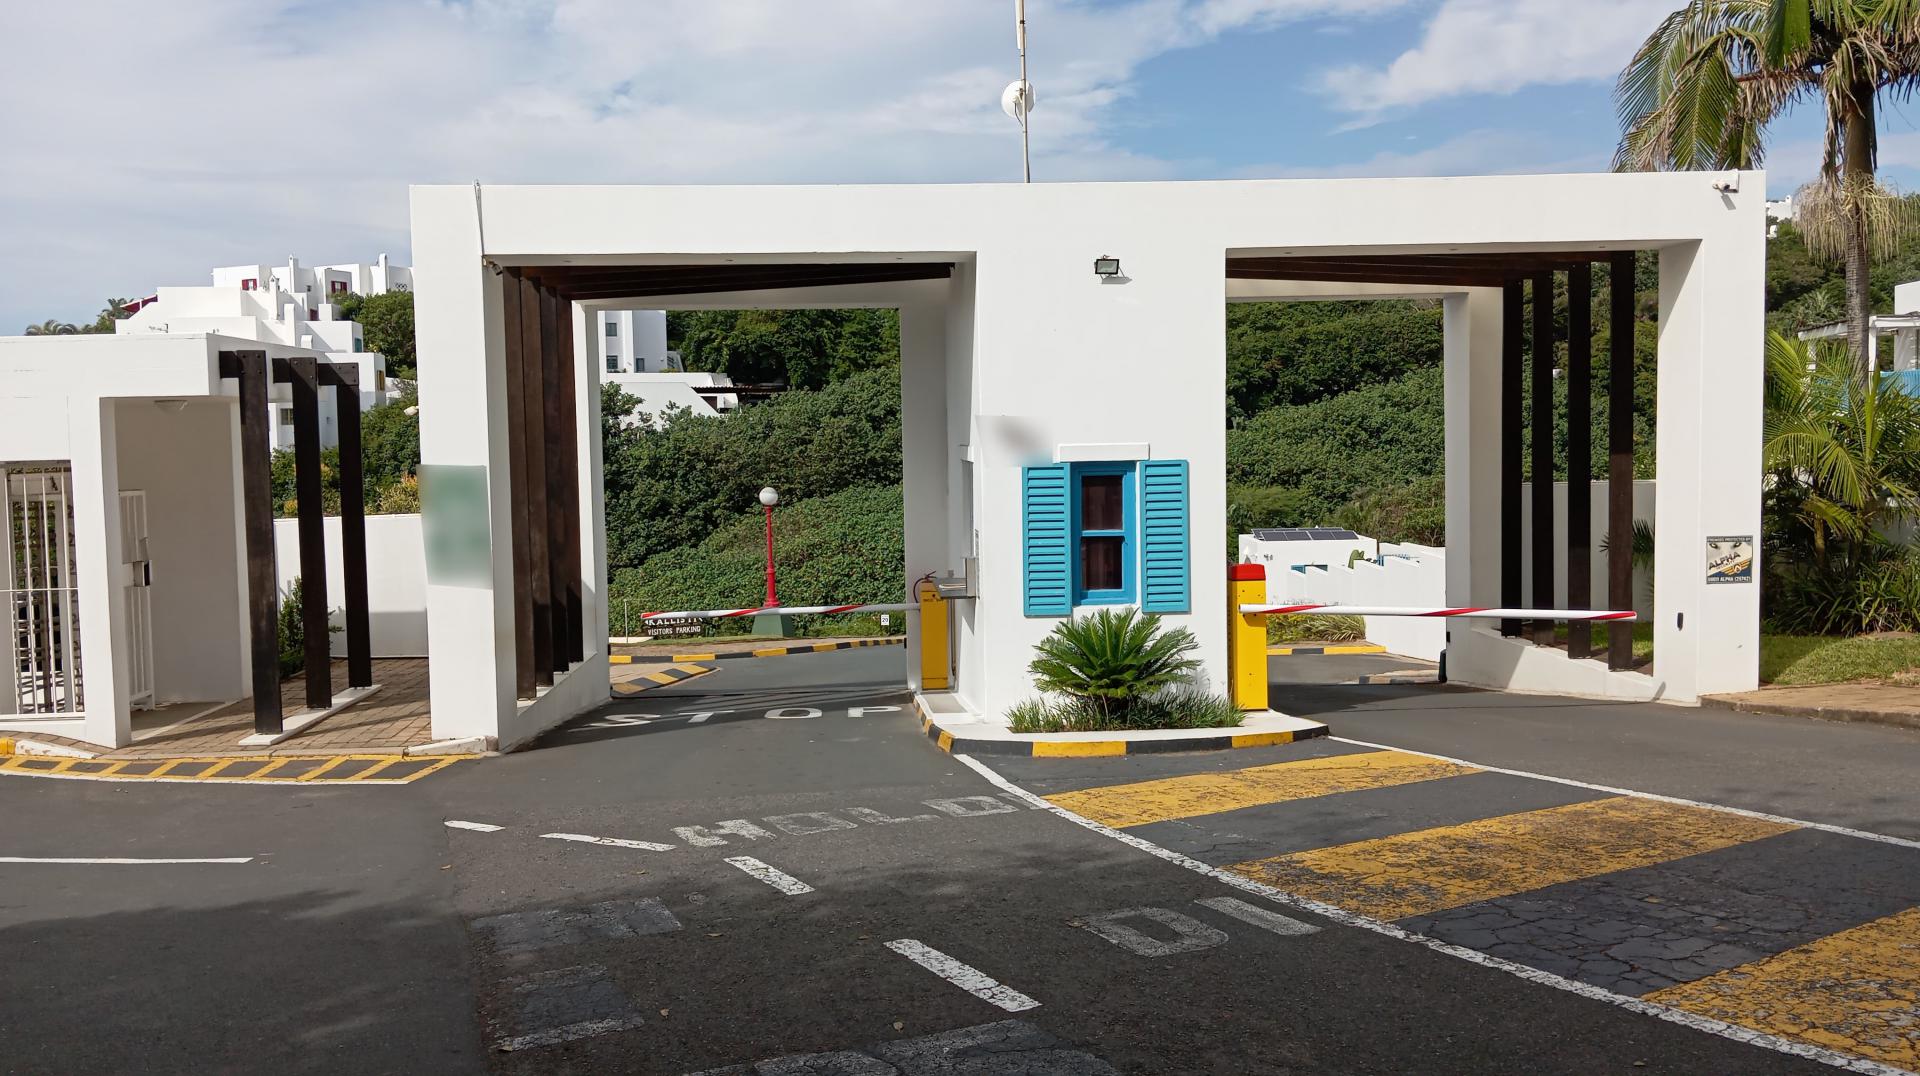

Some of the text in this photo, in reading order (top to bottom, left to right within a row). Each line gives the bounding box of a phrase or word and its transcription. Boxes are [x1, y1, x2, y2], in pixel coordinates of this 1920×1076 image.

[1708, 551, 1741, 570] ALPHA
[647, 625, 701, 636] VISITORS PARKING
[582, 706, 902, 728] STOP
